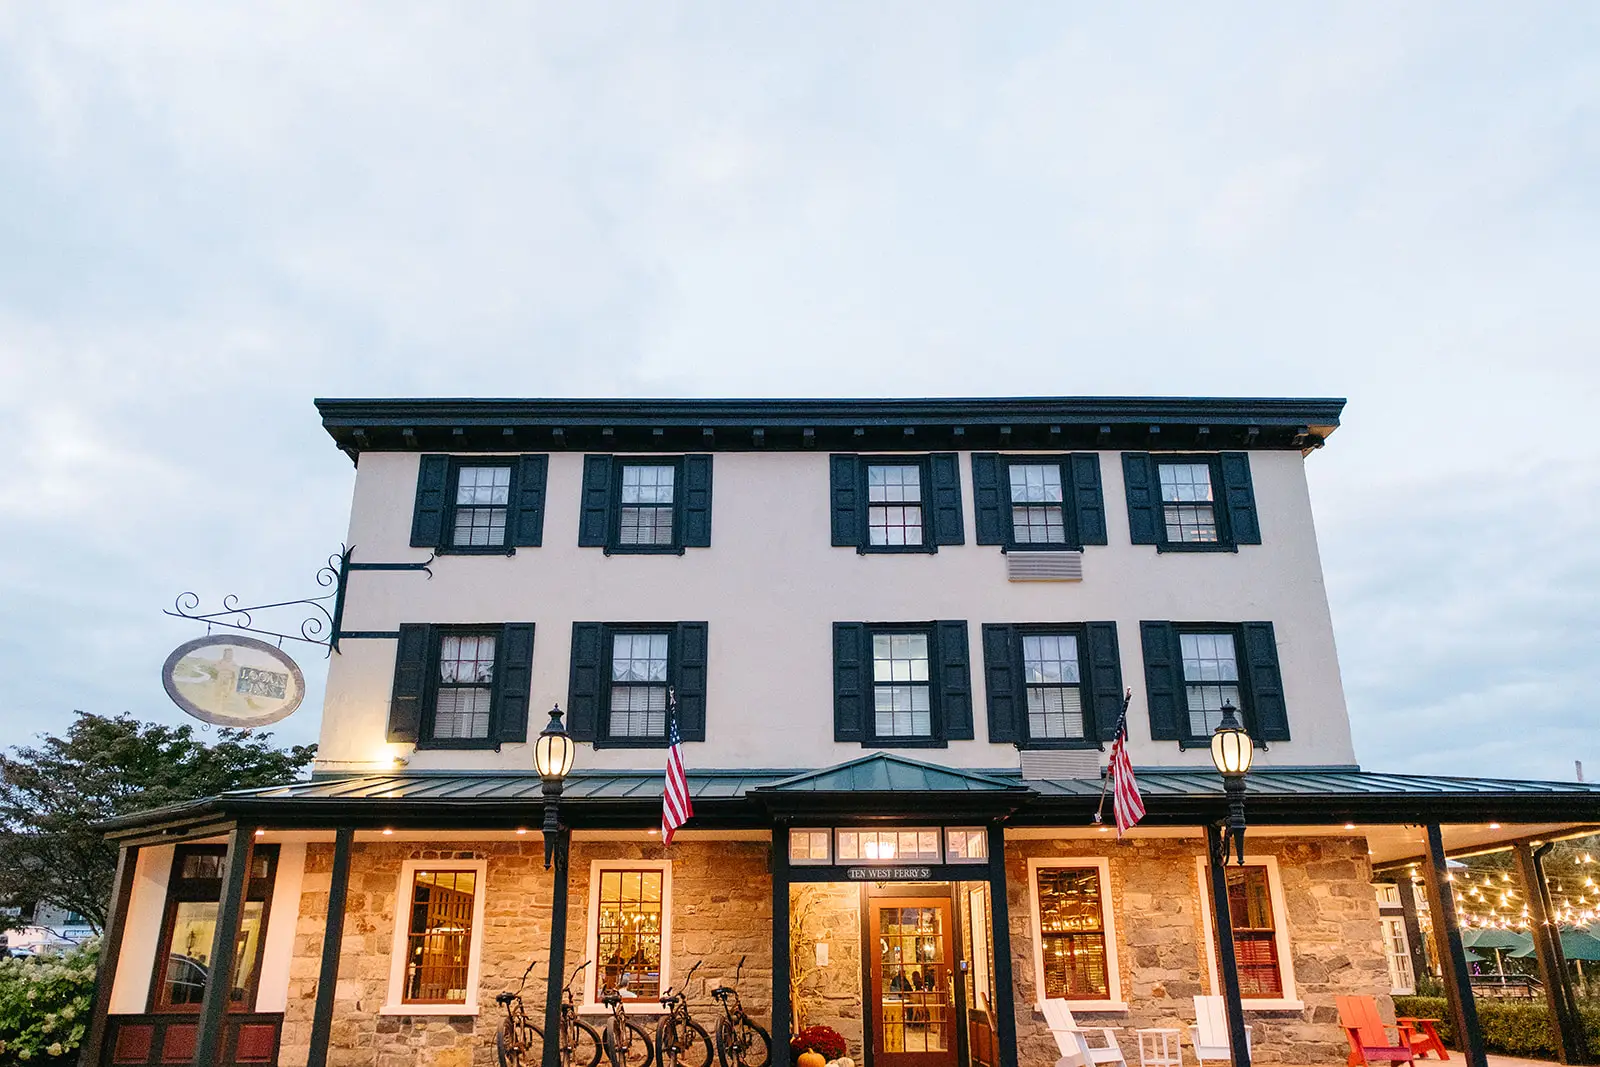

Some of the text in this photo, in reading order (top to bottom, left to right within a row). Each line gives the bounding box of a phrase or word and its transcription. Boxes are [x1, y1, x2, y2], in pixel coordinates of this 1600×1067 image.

[851, 868, 866, 878] TEN
[868, 868, 891, 878] WEST
[894, 868, 920, 878] FERRY
